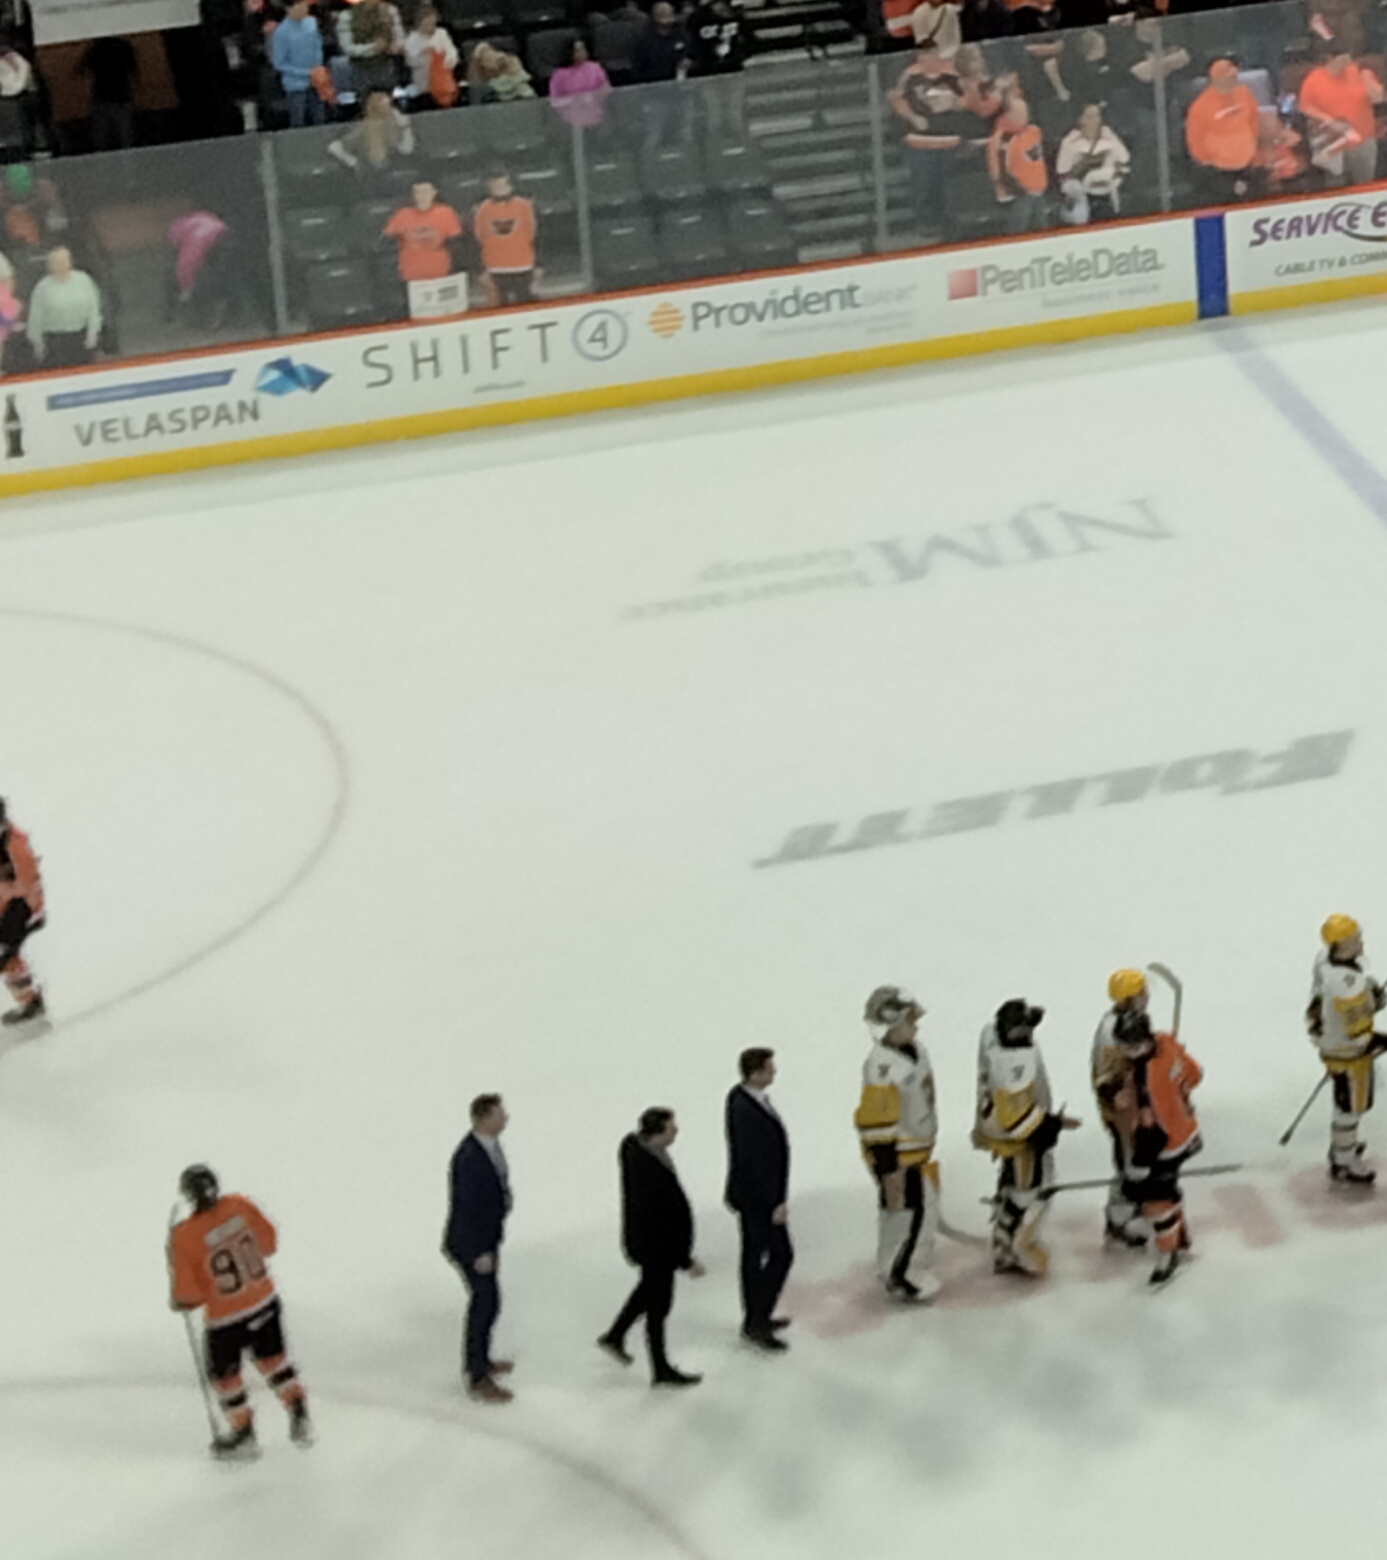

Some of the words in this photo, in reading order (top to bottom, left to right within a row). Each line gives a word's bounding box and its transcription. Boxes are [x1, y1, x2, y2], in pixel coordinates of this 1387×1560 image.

[1249, 205, 1361, 247] SERVICE
[1275, 257, 1317, 277] CABLE
[1318, 256, 1336, 272] TV
[691, 282, 861, 331] Provident
[361, 321, 558, 389] SHIFT
[585, 319, 612, 351] 4
[74, 397, 262, 447] VELASPAN
